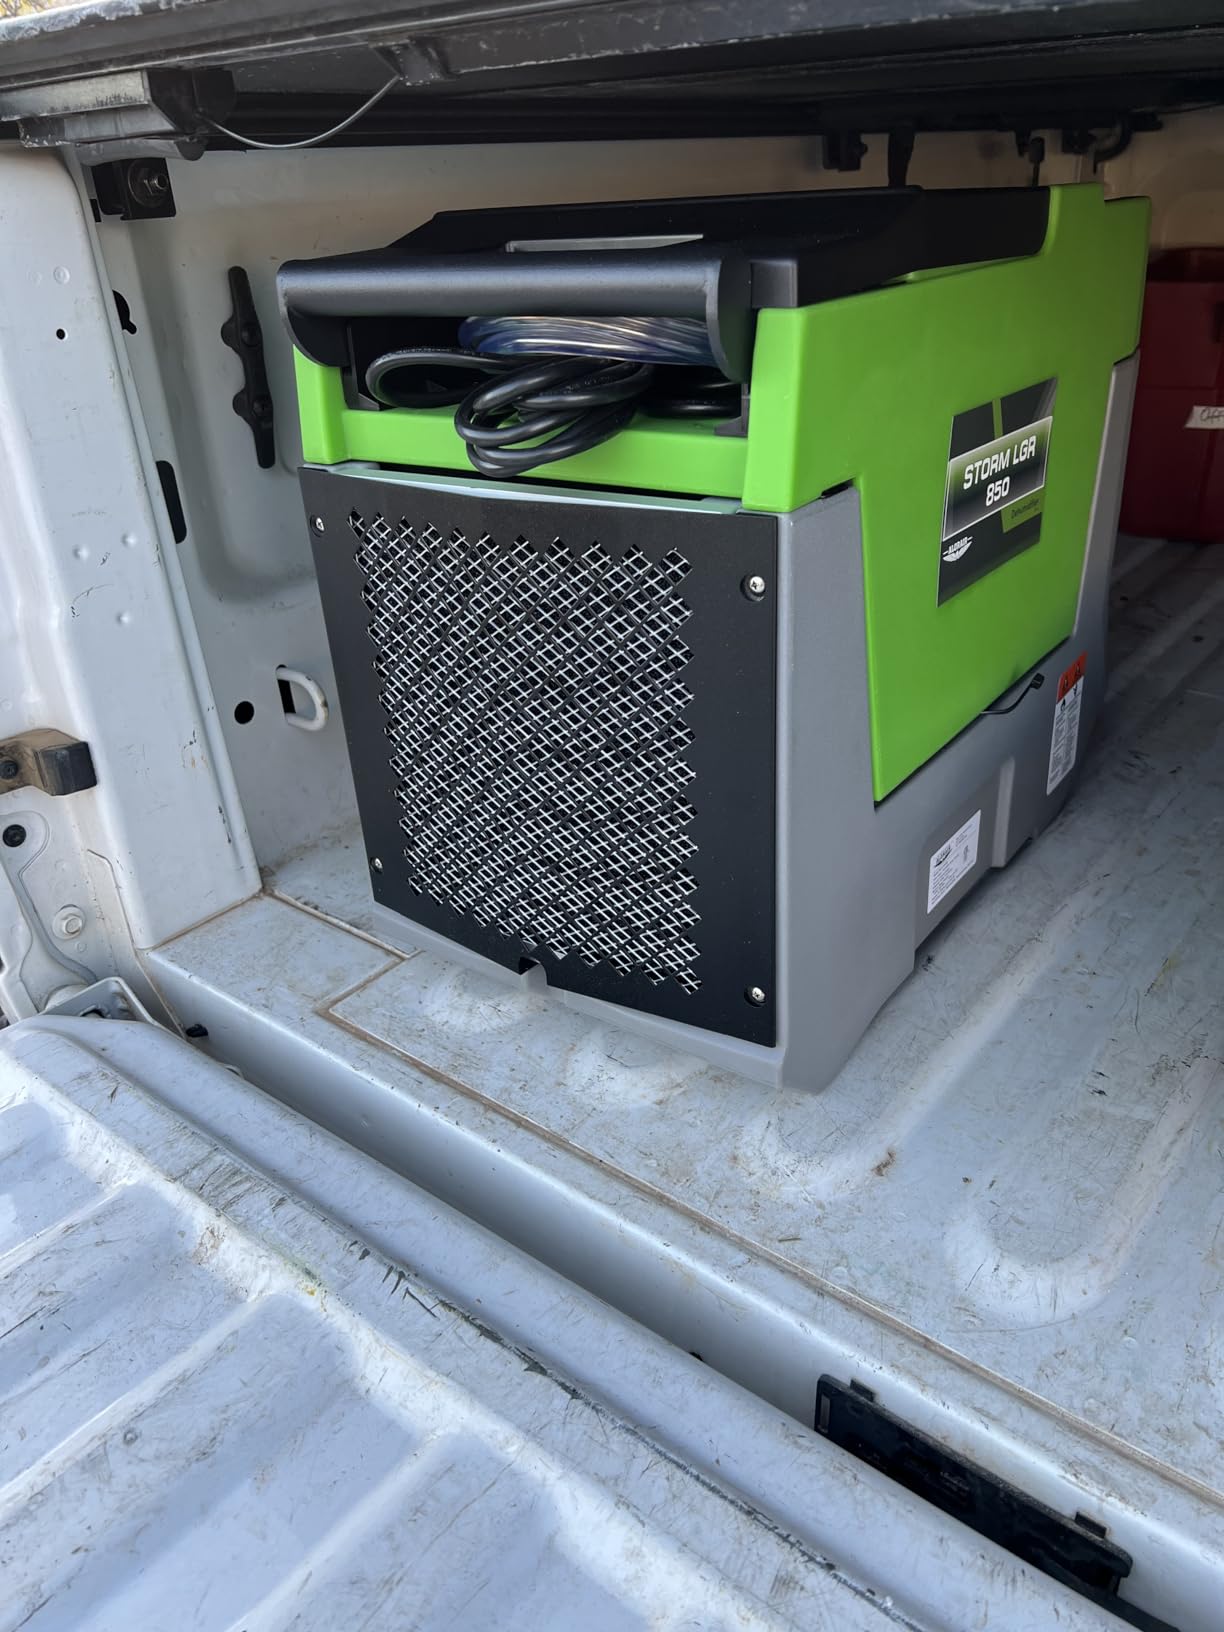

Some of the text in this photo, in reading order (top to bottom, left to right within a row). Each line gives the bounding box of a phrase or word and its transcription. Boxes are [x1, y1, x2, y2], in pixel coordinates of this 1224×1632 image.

[963, 435, 1037, 490] STORM LGR
[985, 476, 1010, 507] 850
